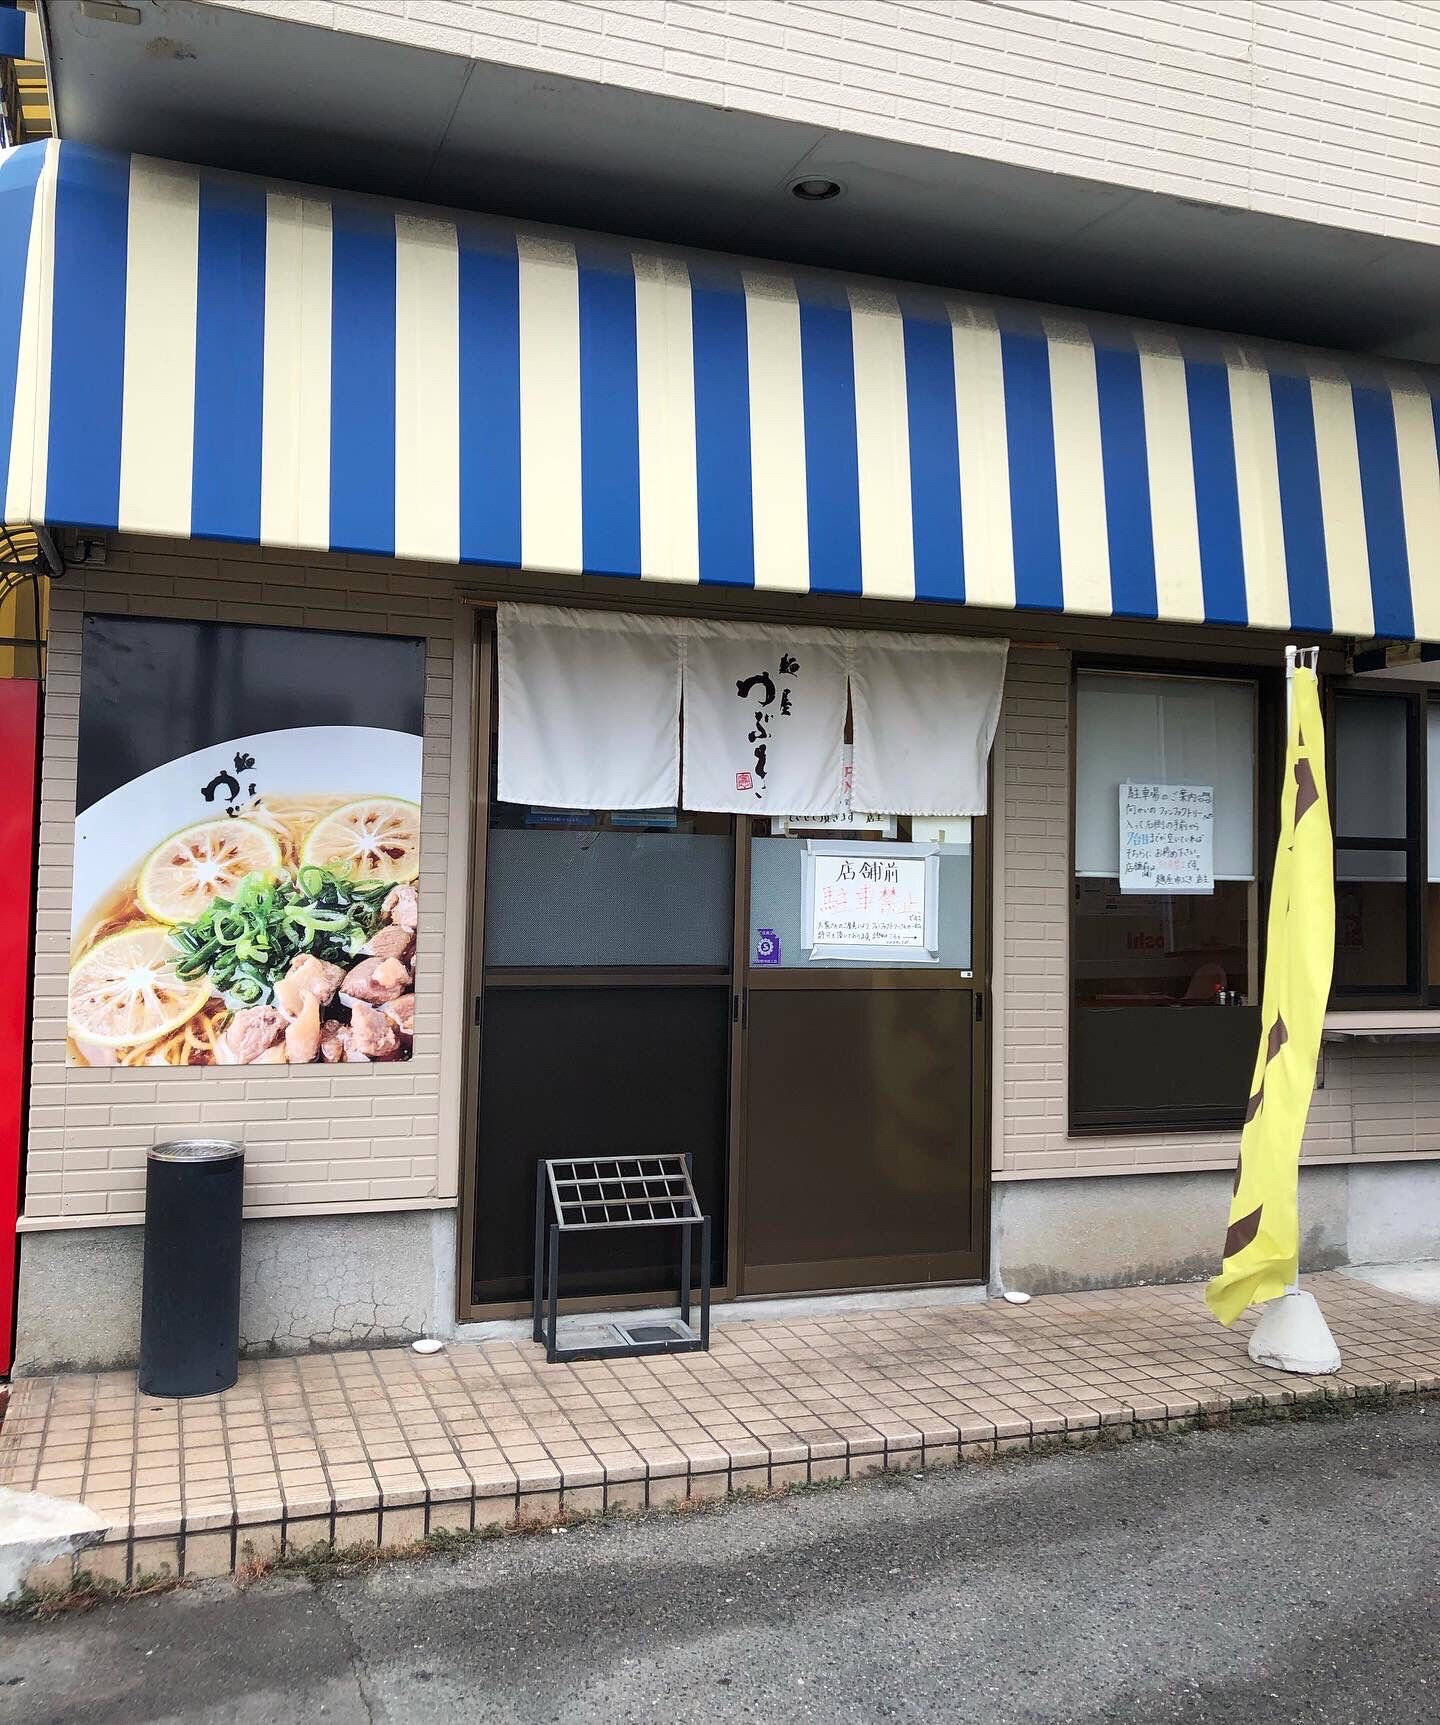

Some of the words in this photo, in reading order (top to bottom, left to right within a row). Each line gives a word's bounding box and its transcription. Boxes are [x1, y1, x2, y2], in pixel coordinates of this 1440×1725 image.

[1127, 786, 1196, 803] 駐車場のご案内
[836, 860, 899, 884] 店舗前
[820, 885, 922, 914] 駐車禁止
